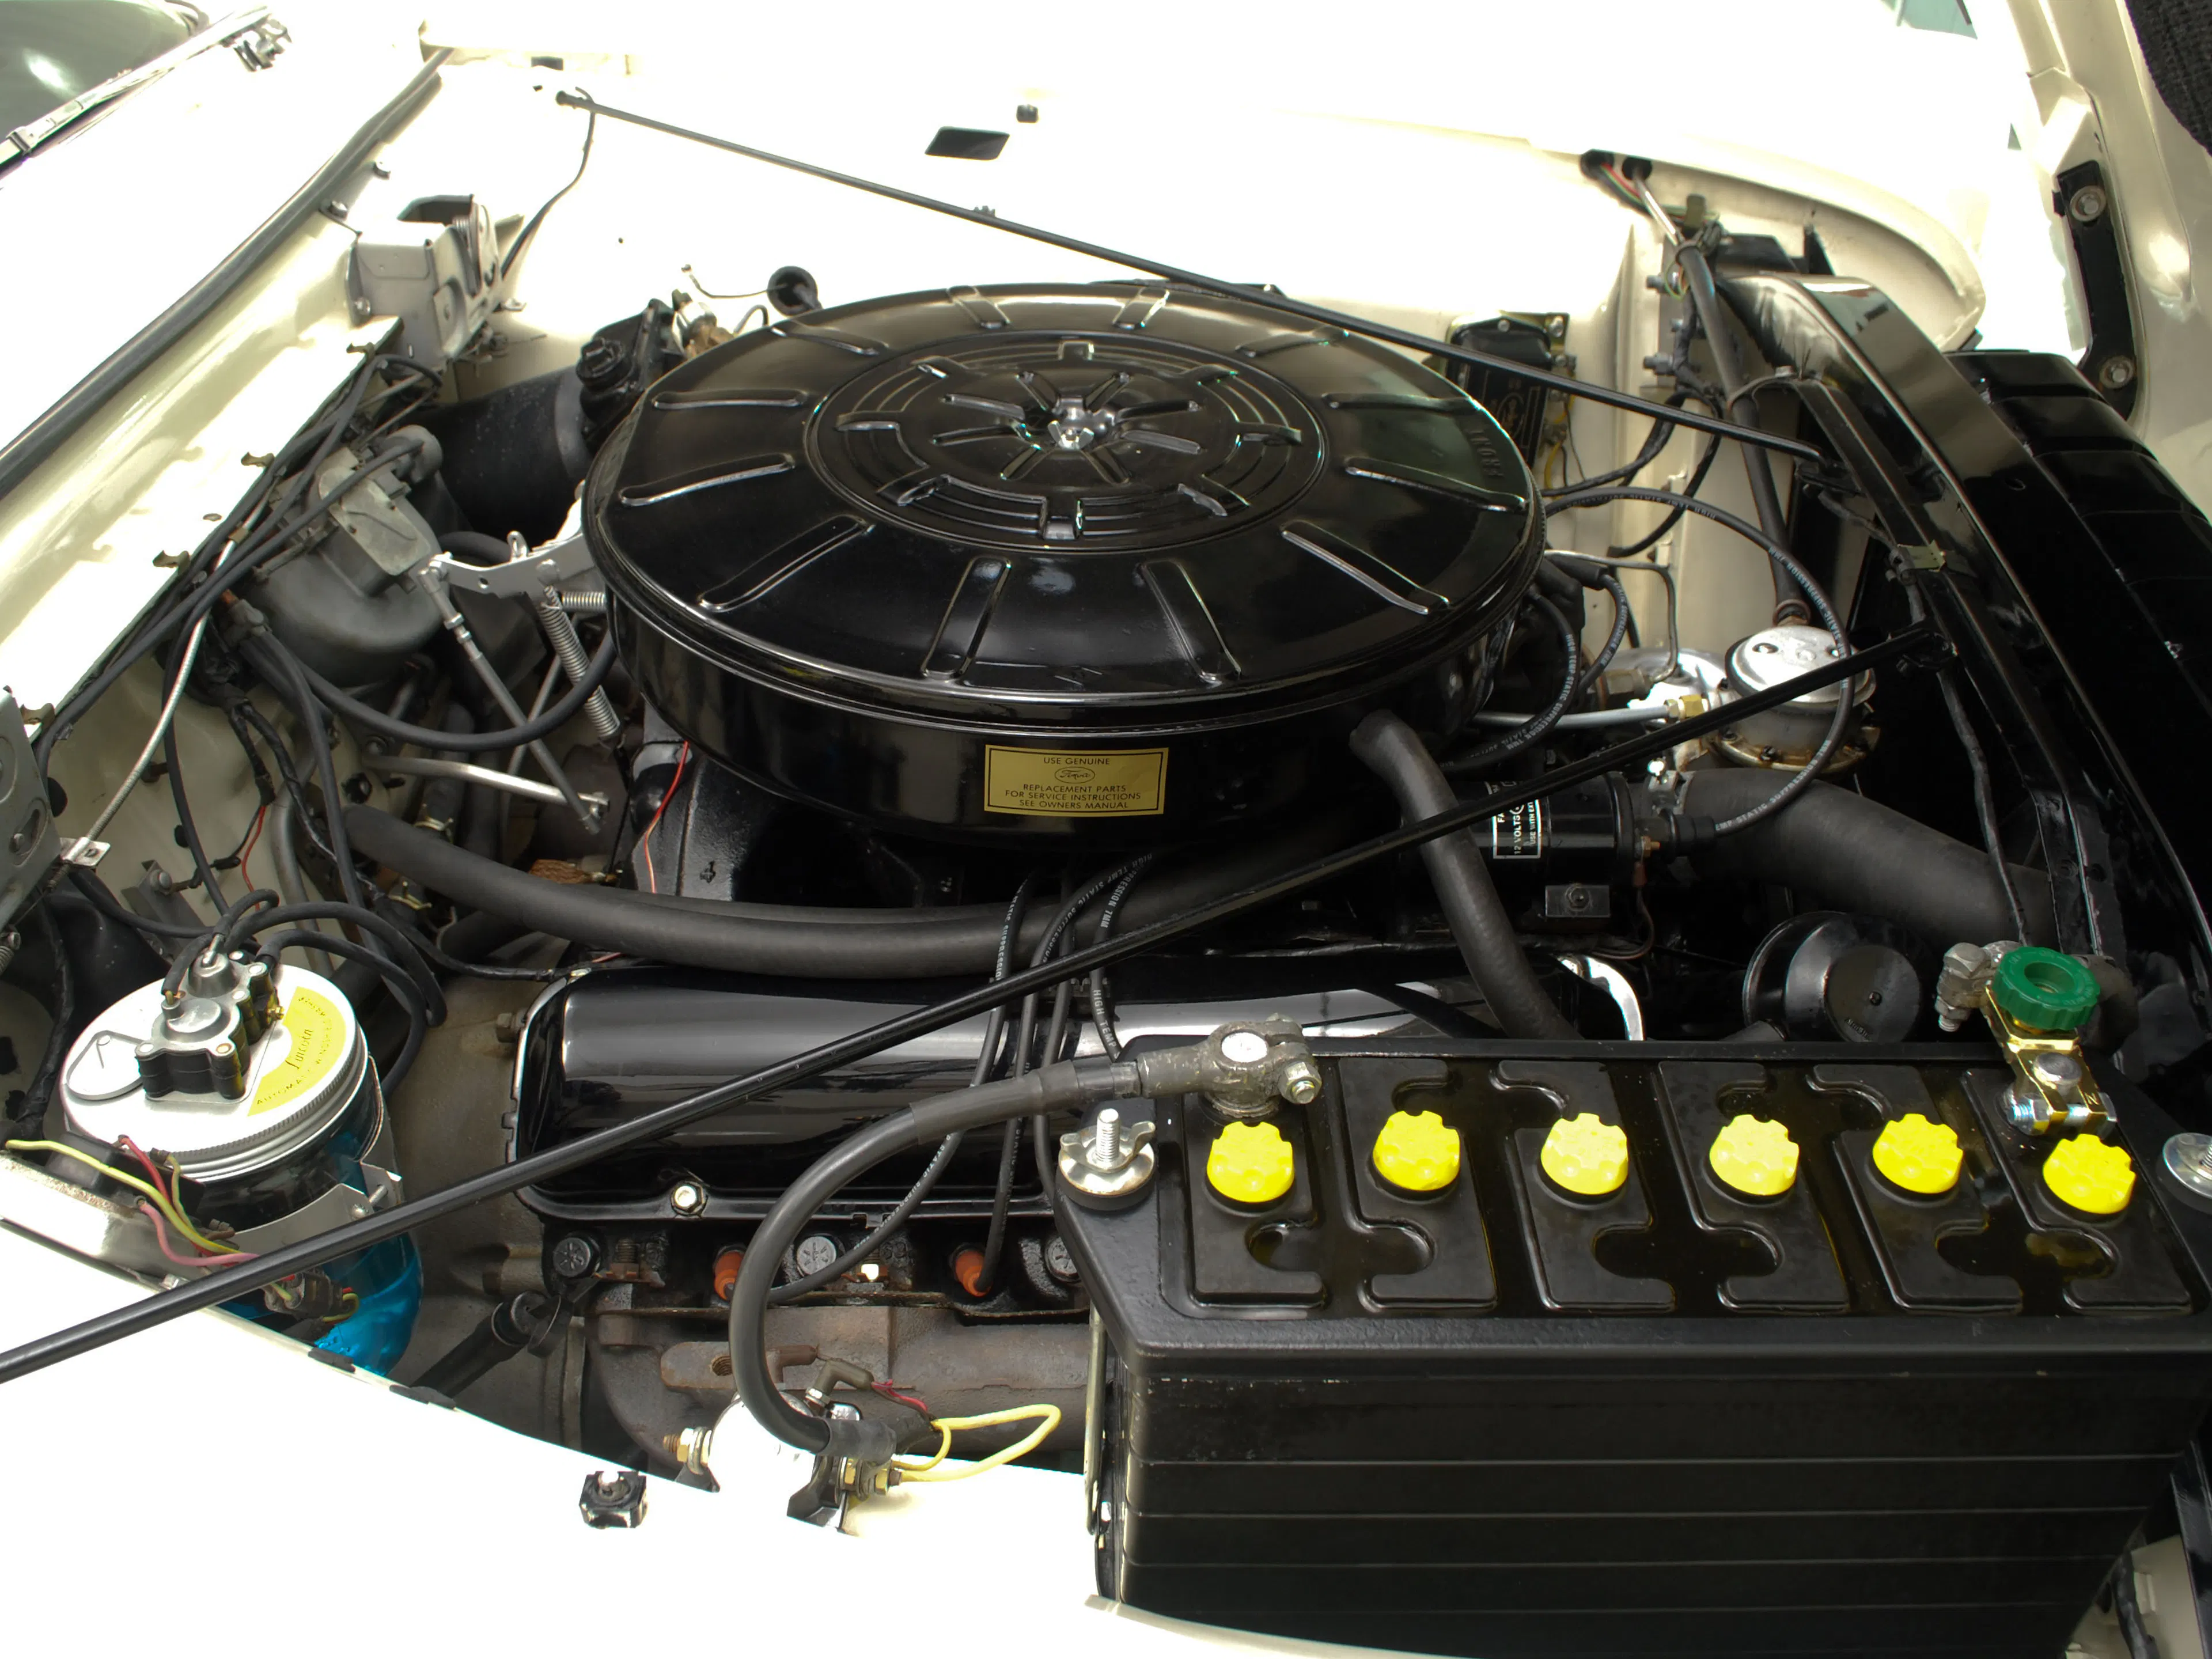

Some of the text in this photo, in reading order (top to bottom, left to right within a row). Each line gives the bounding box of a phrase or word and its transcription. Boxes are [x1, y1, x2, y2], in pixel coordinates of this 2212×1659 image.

[1005, 790, 1141, 801] FOR SERVICE INSTRUCTIONS
[1024, 783, 1092, 793] REPLACEMENT
[1039, 801, 1081, 809] OWNERS
[1085, 801, 1128, 809] MANUAL
[1513, 815, 1521, 854] 12 VOLTS
[1107, 866, 1128, 884] TEMP
[1078, 881, 1105, 907] STATIC
[1100, 910, 1113, 928] 7MM
[1093, 990, 1105, 1015] HIGH
[1100, 1019, 1117, 1047] TEMP
